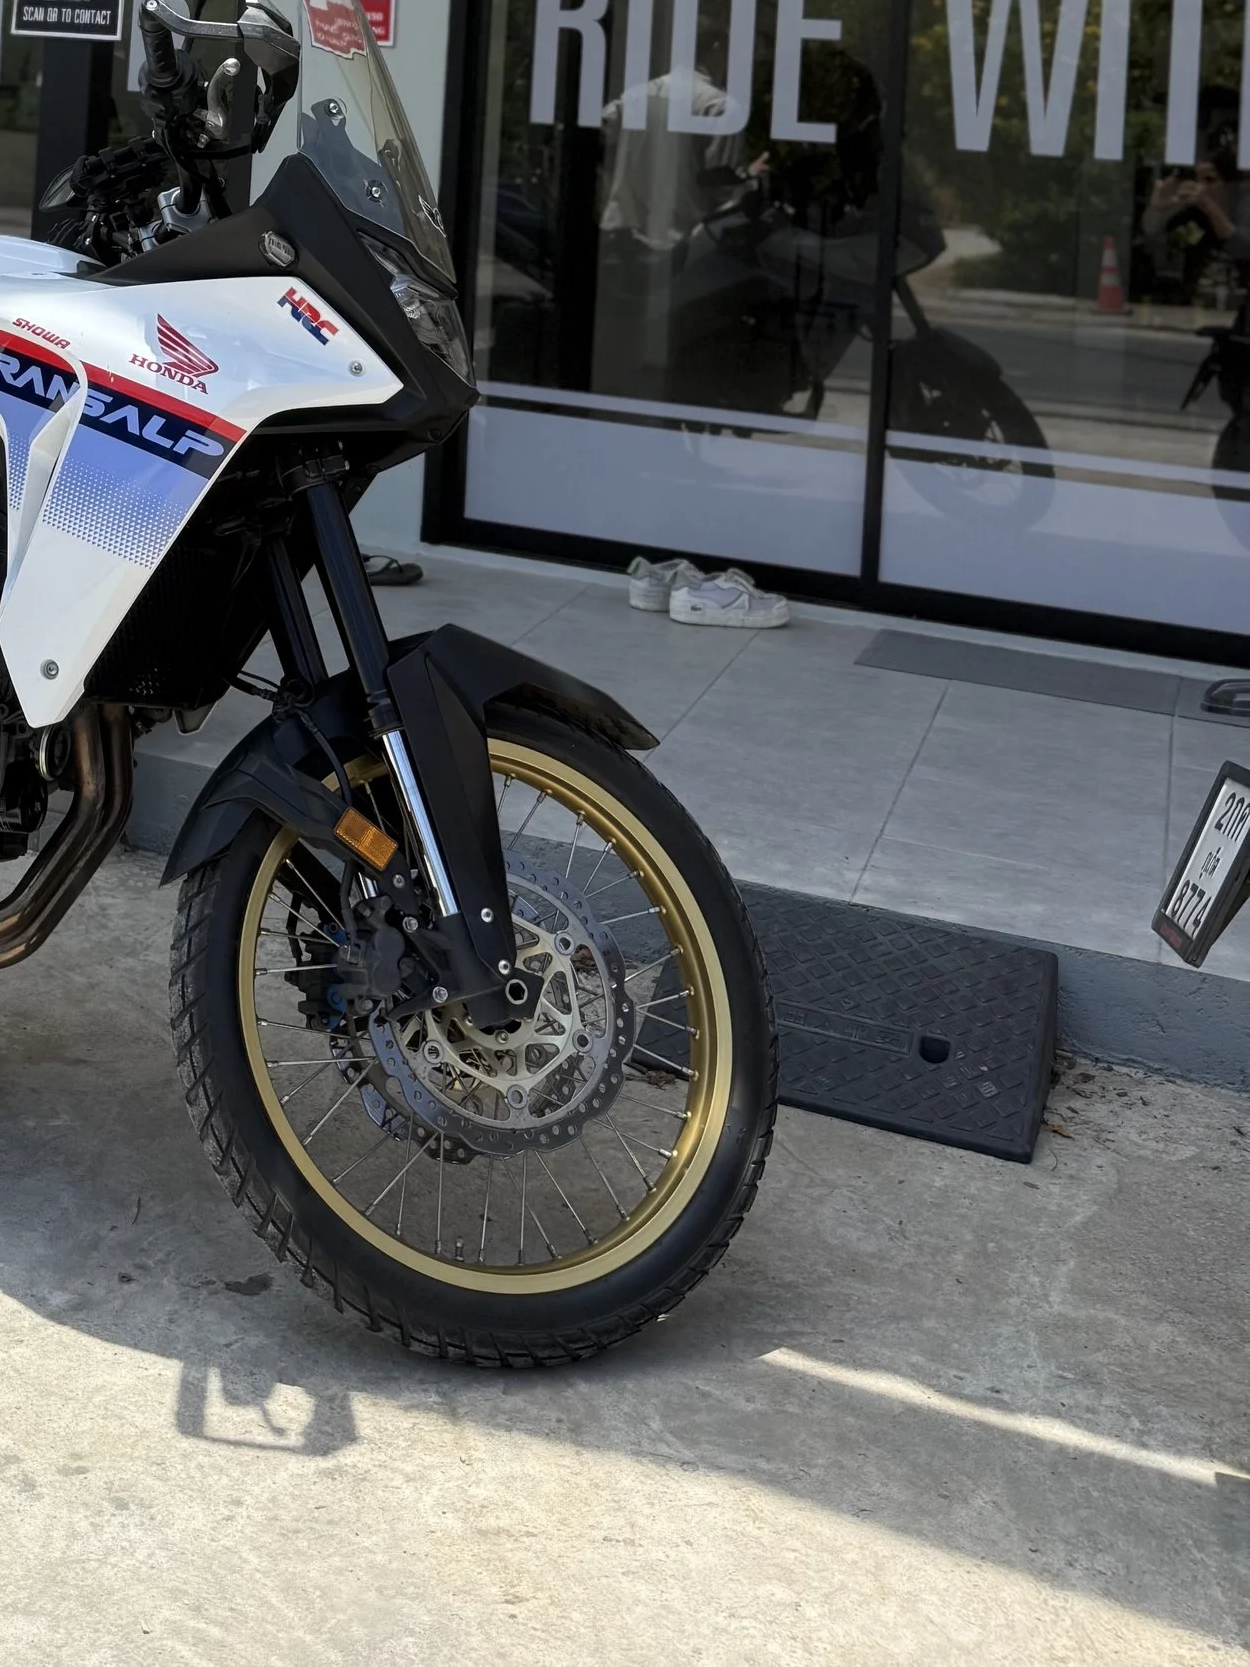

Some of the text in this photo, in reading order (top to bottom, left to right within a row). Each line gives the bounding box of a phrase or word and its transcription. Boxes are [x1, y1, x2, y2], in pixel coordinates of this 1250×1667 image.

[22, 6, 44, 22] SCAN
[61, 8, 72, 23] TO
[74, 9, 112, 25] CONTACT
[12, 317, 72, 350] SHOWA
[128, 353, 209, 395] HONDA
[1170, 879, 1213, 938] 8774
